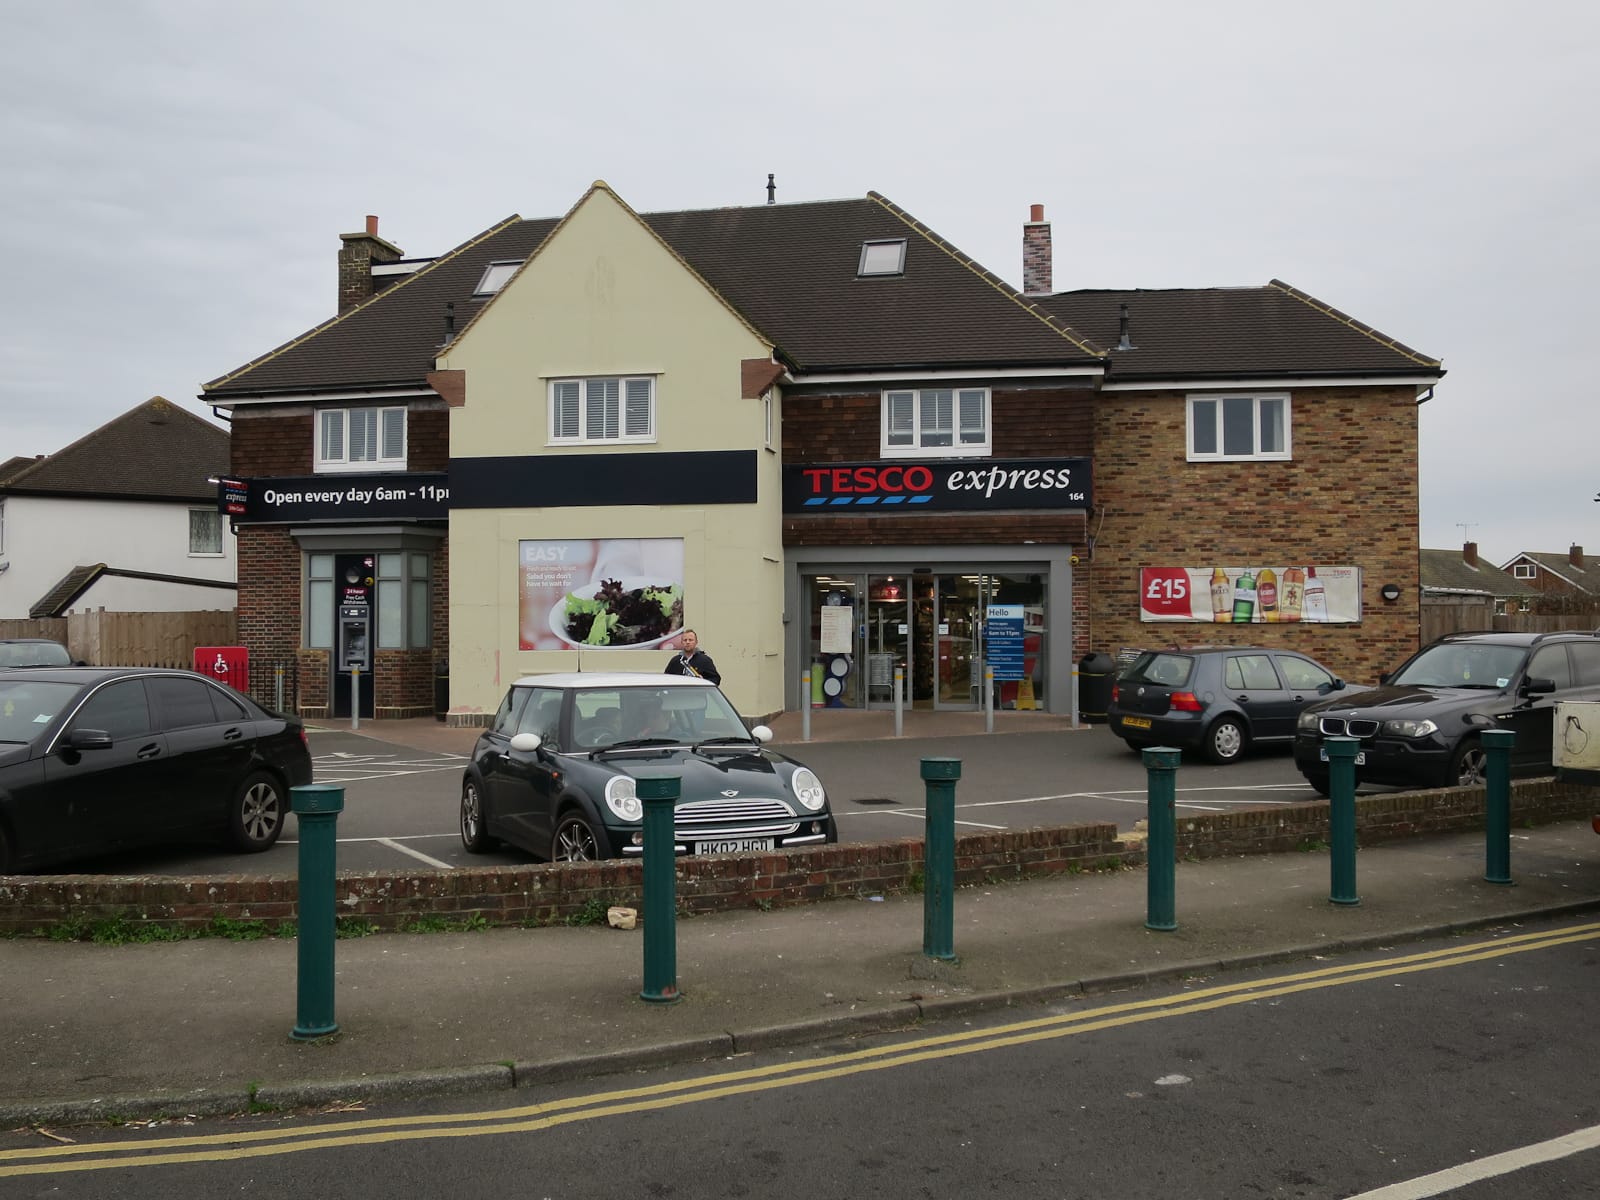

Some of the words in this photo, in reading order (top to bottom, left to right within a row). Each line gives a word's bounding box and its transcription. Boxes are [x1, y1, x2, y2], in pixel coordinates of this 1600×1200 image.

[803, 467, 934, 493] TESCO
[947, 466, 1071, 498] express
[264, 490, 302, 506] Open
[305, 490, 344, 505] every
[346, 488, 373, 504] day
[375, 487, 407, 501] 6am
[418, 486, 449, 502] 11p
[1069, 492, 1084, 501] 164
[526, 546, 568, 561] EASY
[1146, 578, 1186, 599] £15
[988, 608, 1009, 617] Hello
